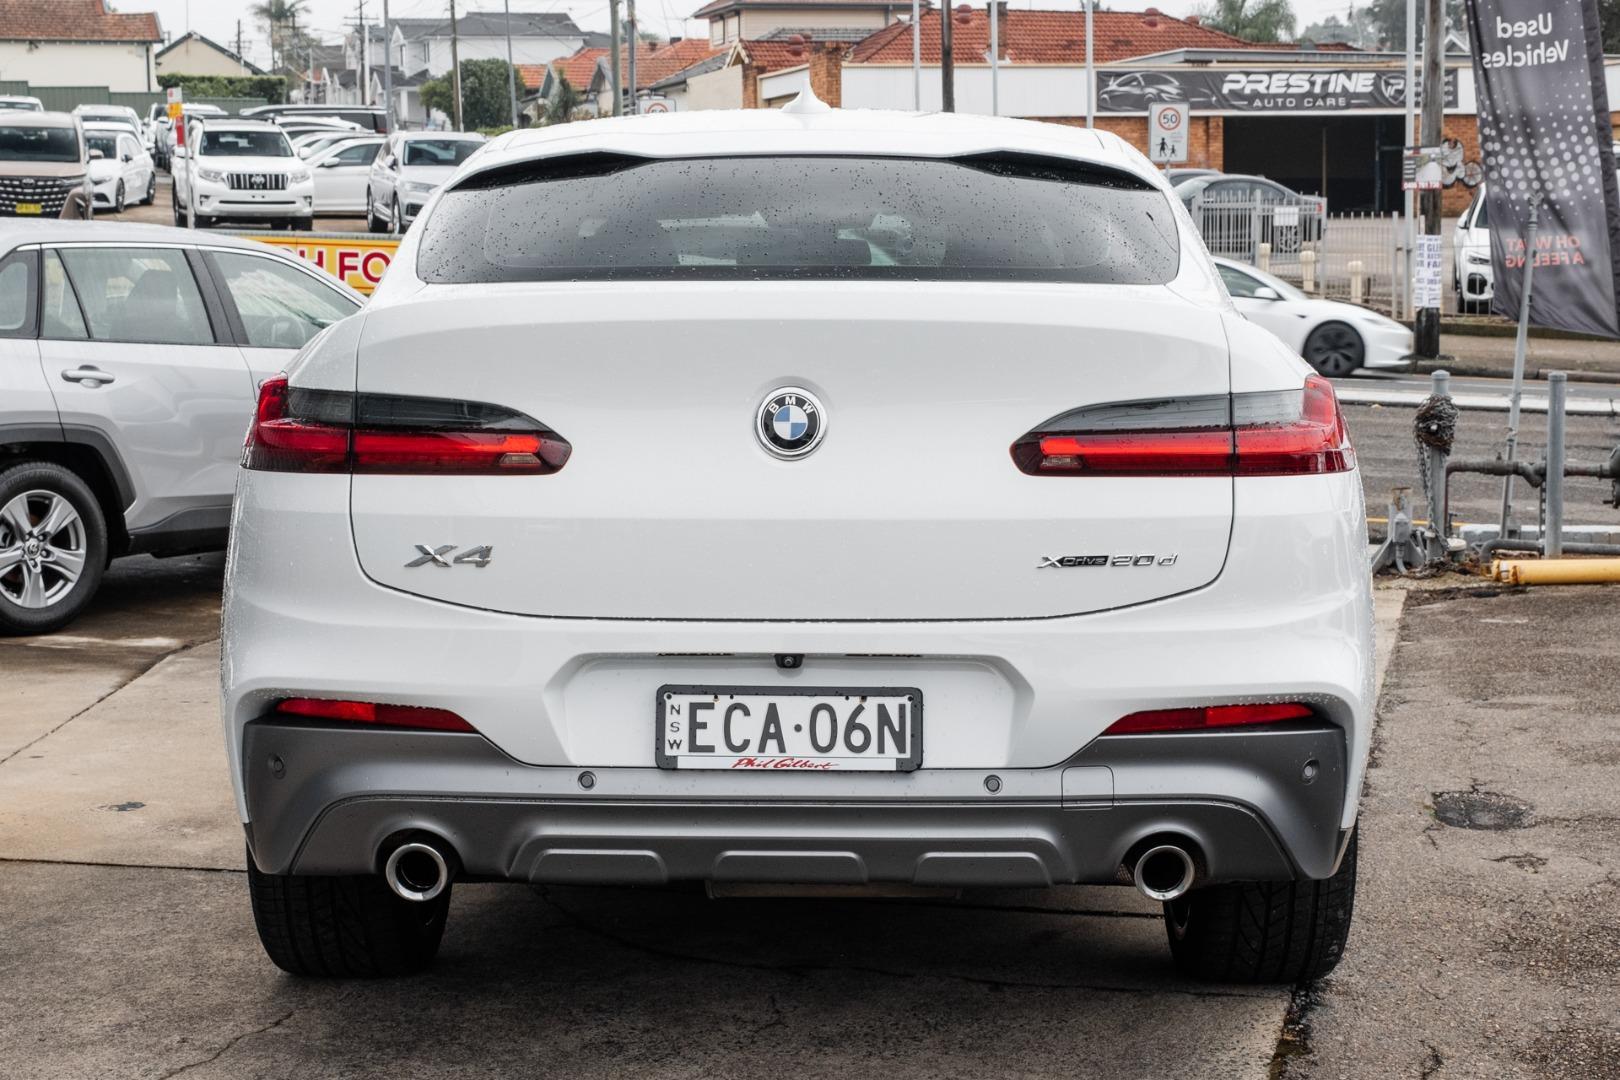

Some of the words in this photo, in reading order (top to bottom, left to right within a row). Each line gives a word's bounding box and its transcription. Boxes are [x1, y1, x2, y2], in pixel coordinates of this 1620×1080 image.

[1222, 72, 1377, 94] PRESTINE
[1253, 98, 1296, 107] AUTO
[1304, 97, 1347, 107] CARE
[1162, 113, 1178, 125] 50
[768, 395, 814, 414] BMW
[404, 544, 493, 568] X4
[732, 757, 776, 769] Phil
[773, 757, 839, 770] Gilbert
